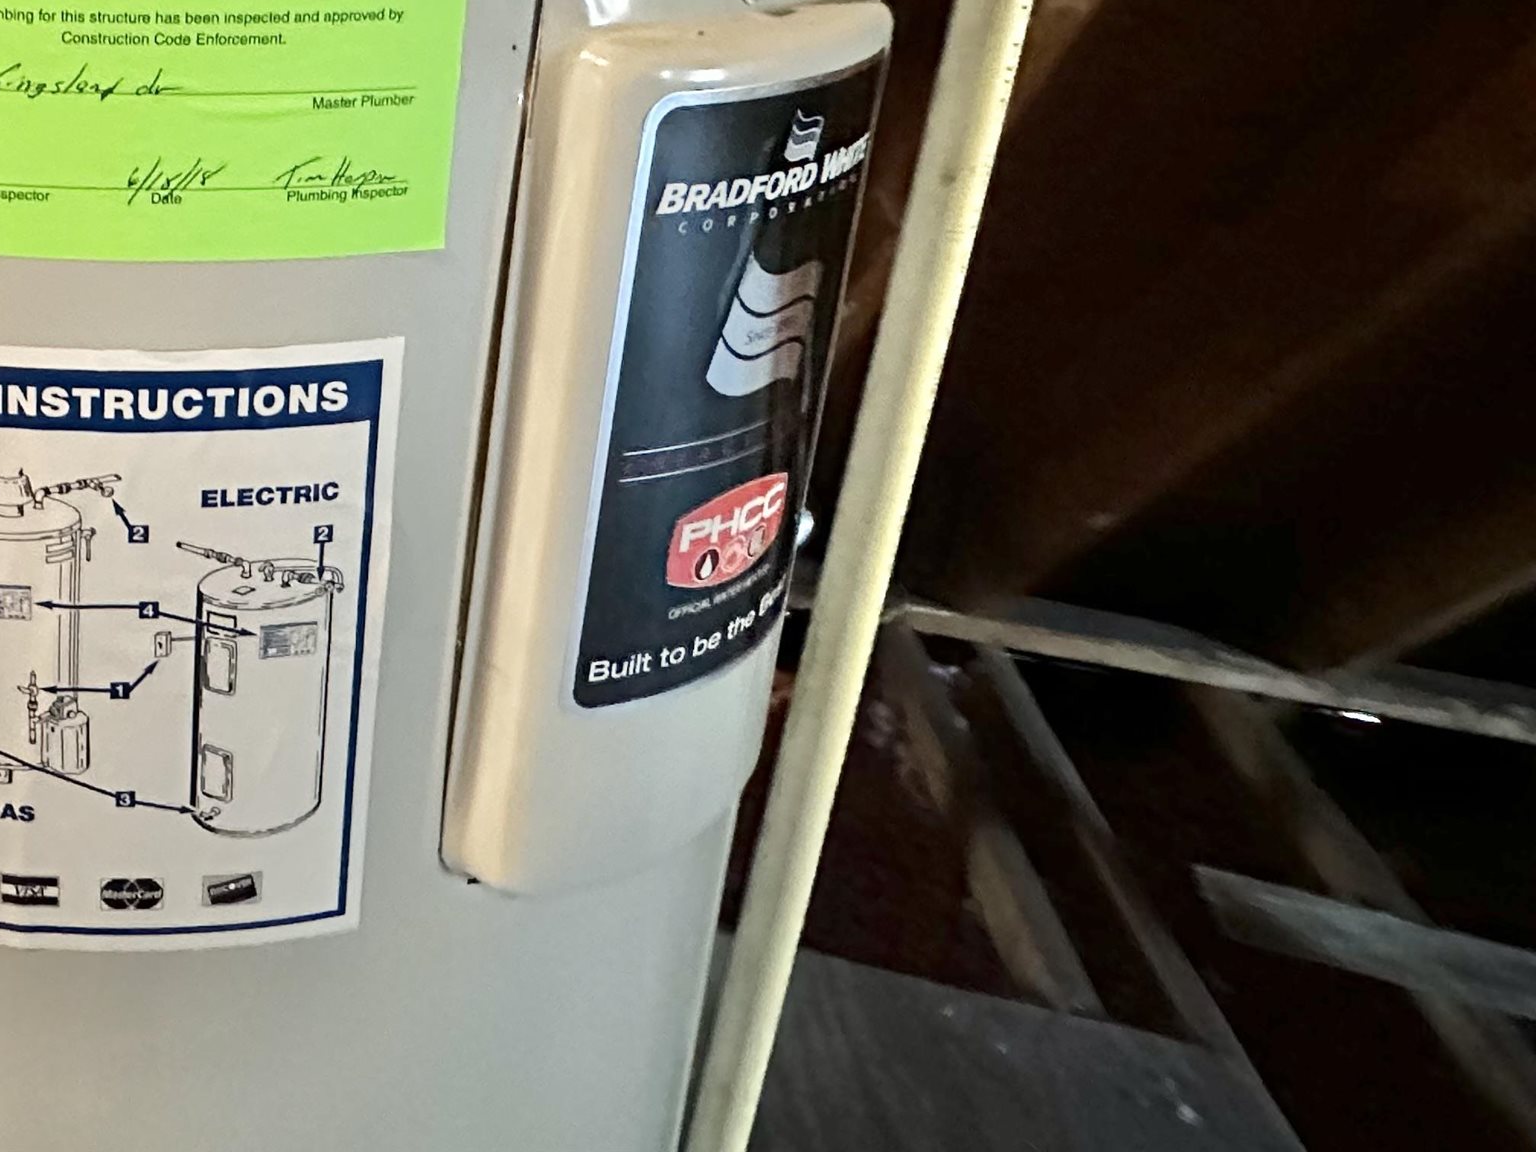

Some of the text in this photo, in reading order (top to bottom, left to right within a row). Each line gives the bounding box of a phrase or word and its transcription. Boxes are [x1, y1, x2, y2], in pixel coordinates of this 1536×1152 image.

[38, 9, 57, 23] for
[61, 10, 85, 24] this
[89, 11, 151, 25] structure
[155, 11, 180, 25] has
[185, 12, 220, 25] been
[224, 12, 290, 27] inspected
[294, 10, 320, 23] and
[323, 8, 385, 25] approved
[388, 8, 404, 25] by
[62, 31, 286, 46] Construction Code Enforcement.
[313, 95, 415, 110] Master Plumber
[287, 185, 408, 203] Plumbing Inspector
[656, 162, 818, 215] BRADFORD
[151, 192, 182, 205] Date
[200, 481, 341, 508] ELECTRIC
[679, 482, 785, 552] PHCC
[132, 527, 145, 541] 2
[318, 527, 329, 541] 2
[142, 603, 155, 617] 4
[588, 654, 653, 682] Built
[660, 646, 685, 669] to
[692, 631, 722, 658] be
[727, 610, 756, 640] the
[119, 793, 131, 806] 3
